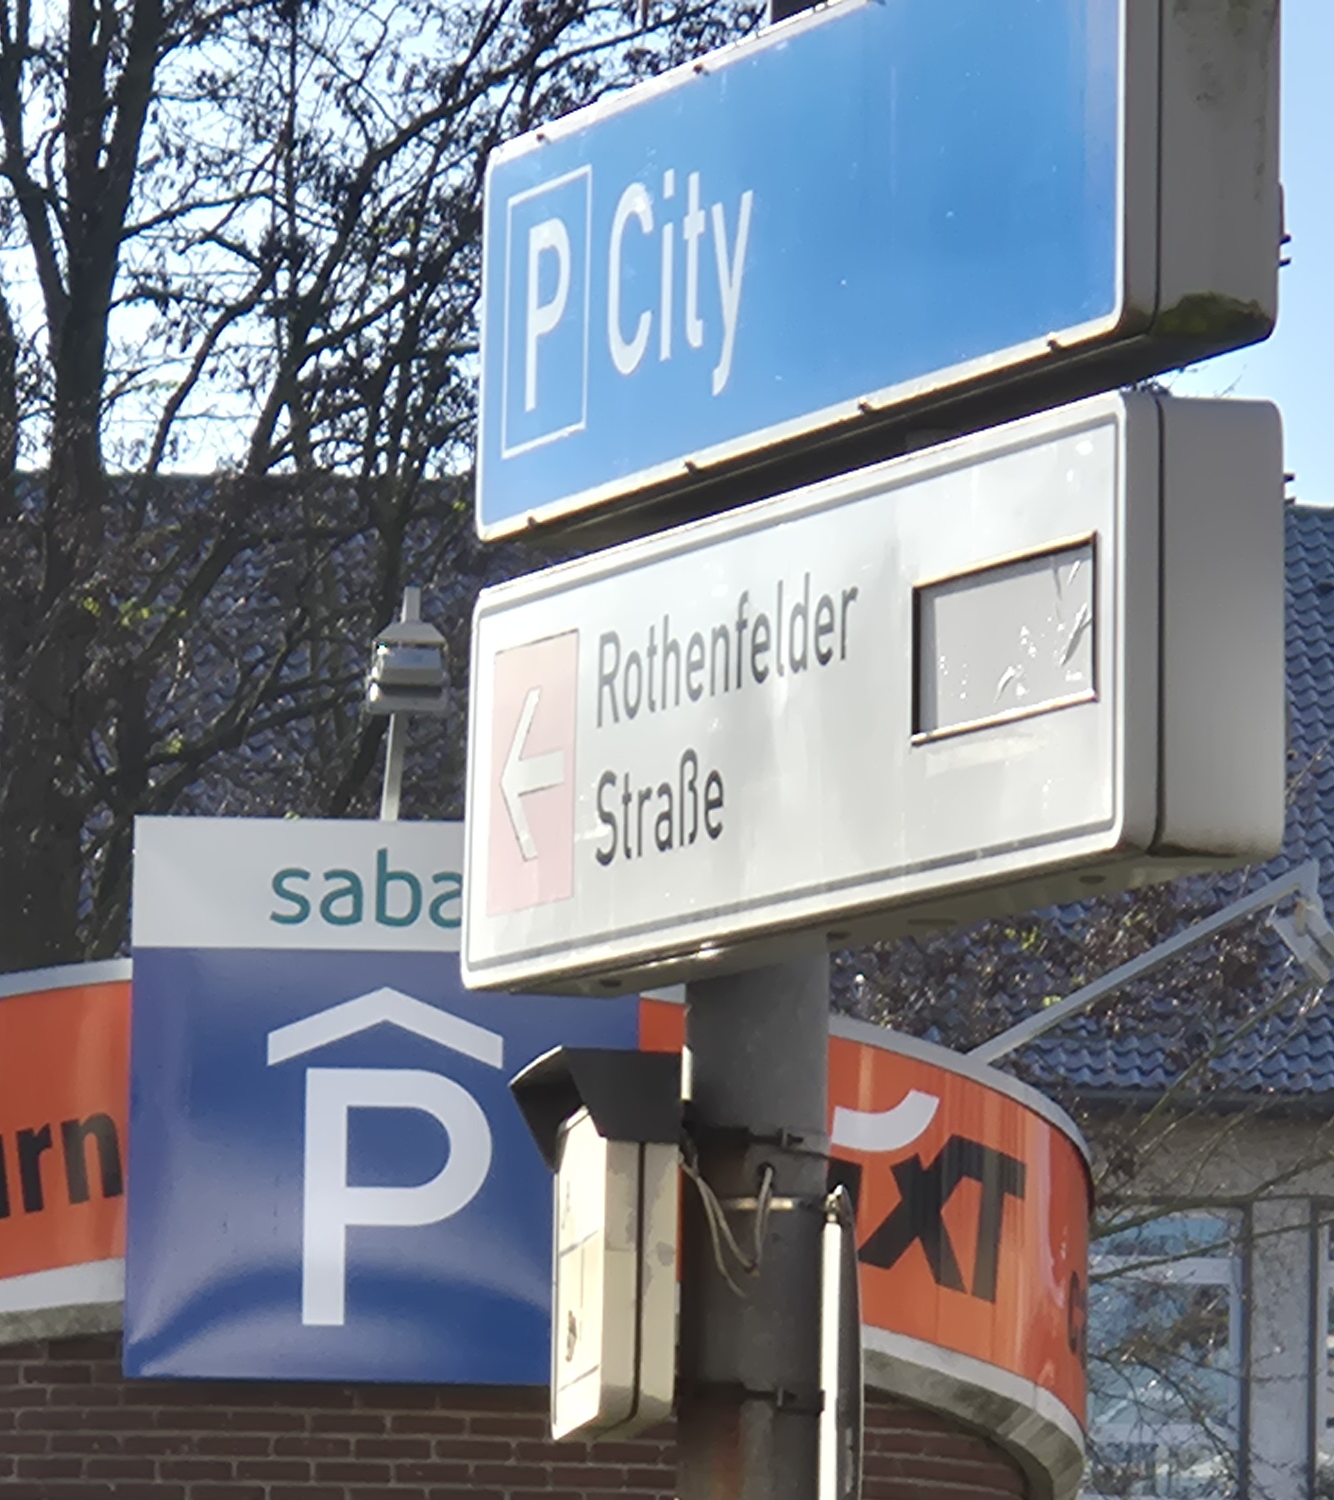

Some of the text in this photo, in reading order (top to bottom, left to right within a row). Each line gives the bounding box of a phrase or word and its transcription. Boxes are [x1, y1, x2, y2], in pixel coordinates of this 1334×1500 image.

[525, 168, 754, 412] P City
[596, 571, 859, 729] Rothenfelder
[595, 748, 724, 866] Straße
[269, 847, 462, 929] saba
[302, 1067, 492, 1325] P
